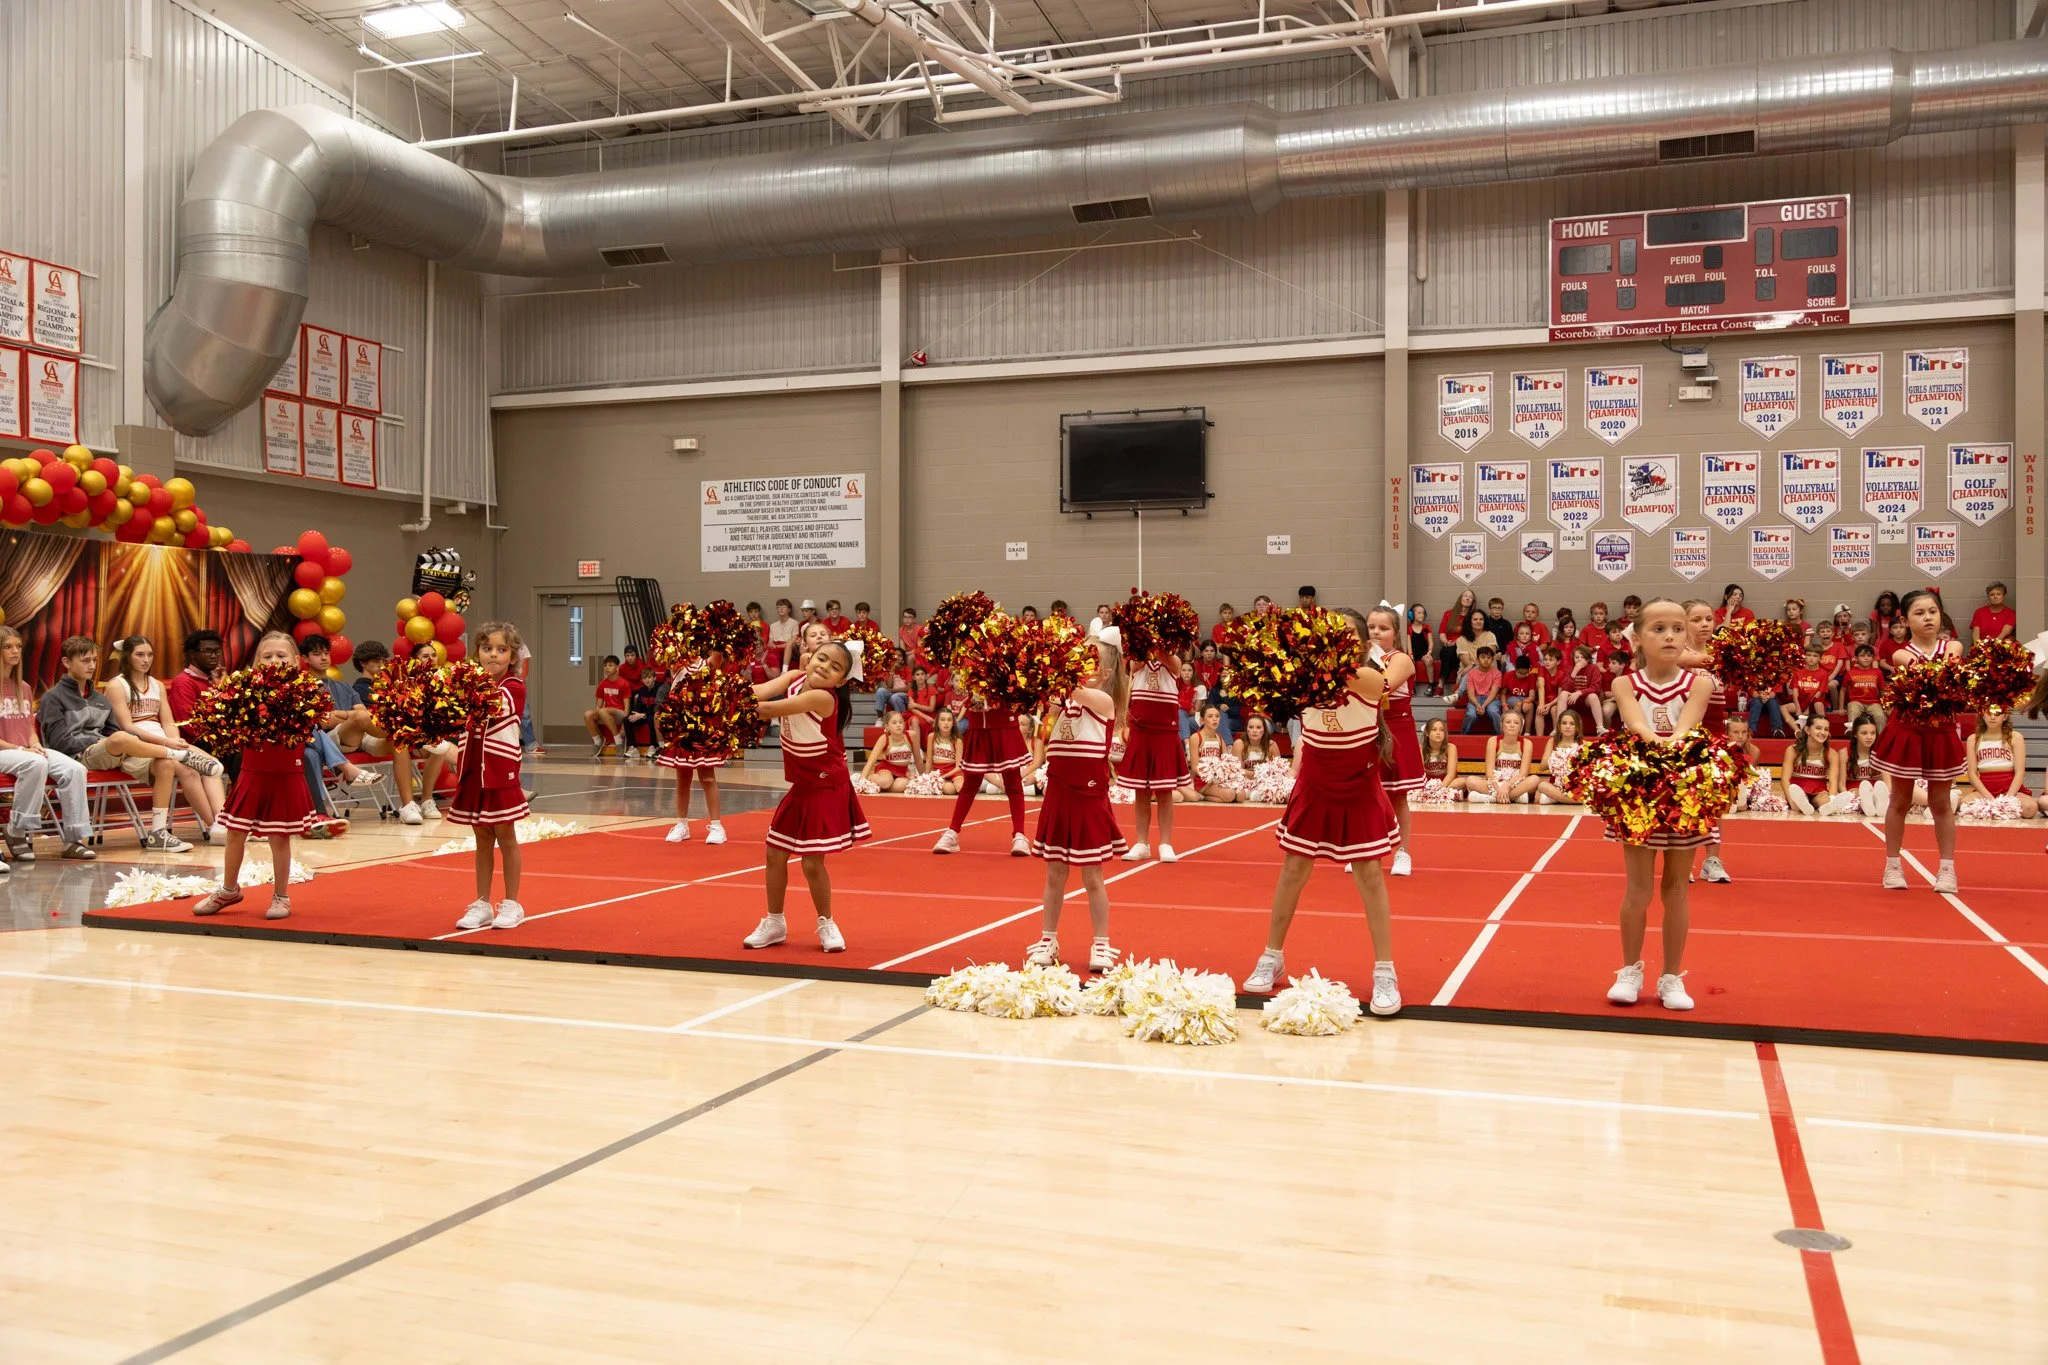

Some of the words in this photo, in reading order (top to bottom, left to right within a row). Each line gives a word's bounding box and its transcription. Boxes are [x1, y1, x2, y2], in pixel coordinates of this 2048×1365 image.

[1780, 202, 1838, 222] GUEST
[1562, 221, 1608, 239] HOME
[1670, 255, 1700, 265] PERIOD
[1755, 268, 1777, 278] T.O.L.
[1808, 264, 1836, 274] FOULS
[1664, 274, 1696, 284] PLAYER
[1704, 272, 1726, 282] FOUL
[1562, 282, 1587, 291] FOULS
[1616, 279, 1636, 288] T.O.L.
[1807, 297, 1836, 307] SCORE
[1680, 306, 1710, 315] MATCH
[1561, 313, 1587, 322] SCORE
[38, 320, 74, 332] CHAMPION
[1554, 326, 1612, 340] Scoreboard
[1616, 324, 1661, 336] Donated
[1664, 322, 1677, 334] by
[1681, 320, 1718, 332] Electra
[1822, 314, 1842, 323] Inc.
[1825, 388, 1877, 399] BASKETBALL
[1908, 386, 1927, 394] GIRLS
[1928, 384, 1962, 393] ATHLETICS
[1744, 390, 1795, 402] VOLLEYBALL
[1909, 393, 1962, 404] CHAMPION
[1516, 403, 1562, 413] VOLLEYBALL
[1589, 399, 1637, 409] VOLLEYBALL
[1744, 401, 1795, 413] CHAMPION
[1824, 398, 1878, 410] RUNNERUP
[1589, 408, 1637, 419] CHAMPION
[1837, 411, 1864, 420] 2021
[1921, 407, 1948, 415] 2021
[1443, 415, 1489, 426] CHAMPIONS
[1516, 412, 1563, 423] CHAMPION
[1756, 414, 1782, 423] 2021
[1600, 421, 1626, 430] 2020
[1765, 424, 1775, 432] 1A
[1455, 428, 1477, 439] 2018
[1530, 431, 1550, 439] 2018
[724, 481, 765, 493] ATHLETICS
[768, 479, 789, 491] CODE
[792, 479, 801, 490] OF
[804, 477, 842, 489] CONDUCT
[1784, 483, 1835, 494] VOLLEYBALL
[1866, 481, 1919, 492] VOLLEYBALL
[1964, 479, 1996, 489] GOLF
[1705, 485, 1755, 495] TENNIS
[1953, 489, 2008, 500] CHAMPION
[2023, 455, 2037, 535] WARRIORS
[1414, 495, 1459, 505] VOLLEYBALL
[1479, 494, 1525, 503] BASKETBALL
[1551, 491, 1599, 500] BASKETBALL
[1705, 495, 1755, 506] CHAMPION
[1784, 493, 1835, 504] CHAMPION
[1866, 491, 1918, 502] CHAMPION
[1414, 504, 1459, 515] CHAMPION
[1478, 502, 1525, 513] CHAMPIONS
[1551, 500, 1599, 510] CHAMPIONS
[1626, 505, 1674, 515] CHAMPION
[1797, 506, 1823, 514] 2023
[1878, 504, 1906, 513] 2024
[1966, 502, 1994, 511] 2025
[1391, 478, 1401, 549] WARRIORS
[1563, 512, 1588, 520] 2022
[1717, 508, 1743, 516] 2023
[1425, 516, 1448, 524] 2022
[1490, 514, 1513, 523] 2022
[1497, 524, 1506, 532] 1A
[1832, 557, 1869, 565] CHAMPION
[582, 563, 597, 575] EXIT
[1453, 563, 1484, 571] CHAMPION
[1976, 747, 2011, 760] ARRIORS
